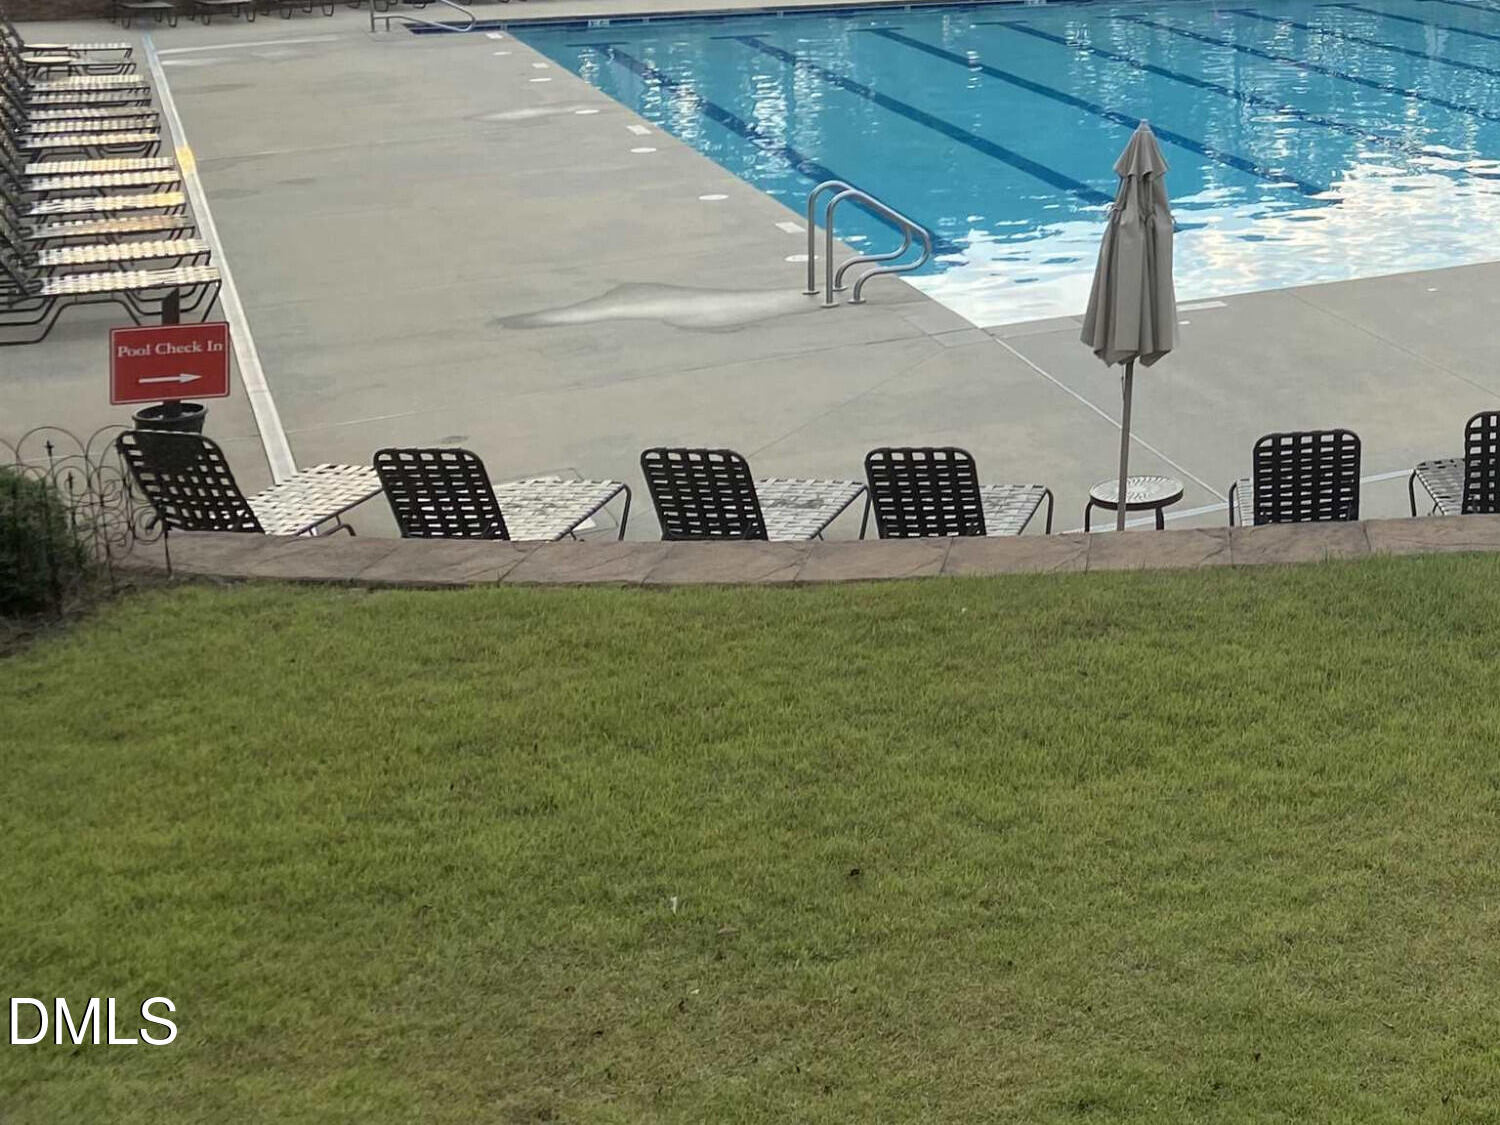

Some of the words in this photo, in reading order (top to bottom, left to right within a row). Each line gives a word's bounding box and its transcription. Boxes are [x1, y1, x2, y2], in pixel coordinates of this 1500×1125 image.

[117, 344, 151, 357] Pool
[155, 341, 202, 355] Check
[207, 340, 223, 352] In
